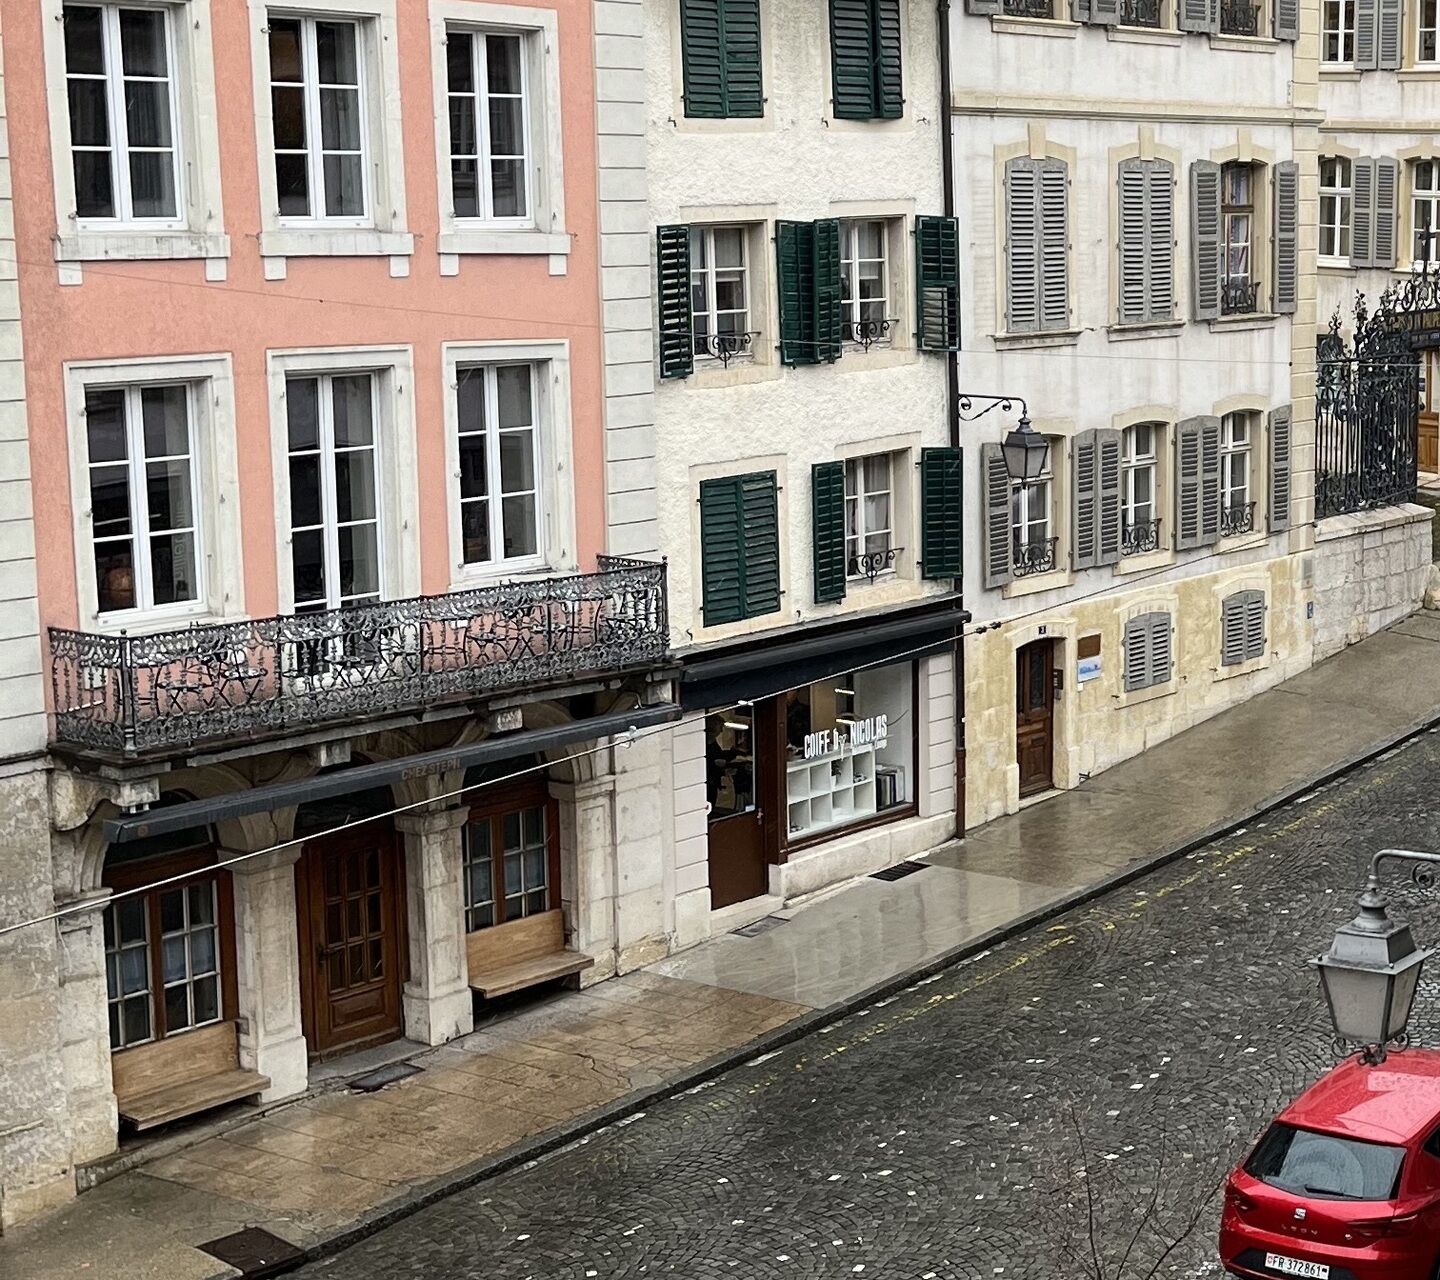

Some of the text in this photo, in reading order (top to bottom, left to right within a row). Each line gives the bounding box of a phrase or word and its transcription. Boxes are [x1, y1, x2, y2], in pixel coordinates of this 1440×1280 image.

[850, 714, 888, 746] NICOLAS
[1272, 1256, 1322, 1276] FR 372861
